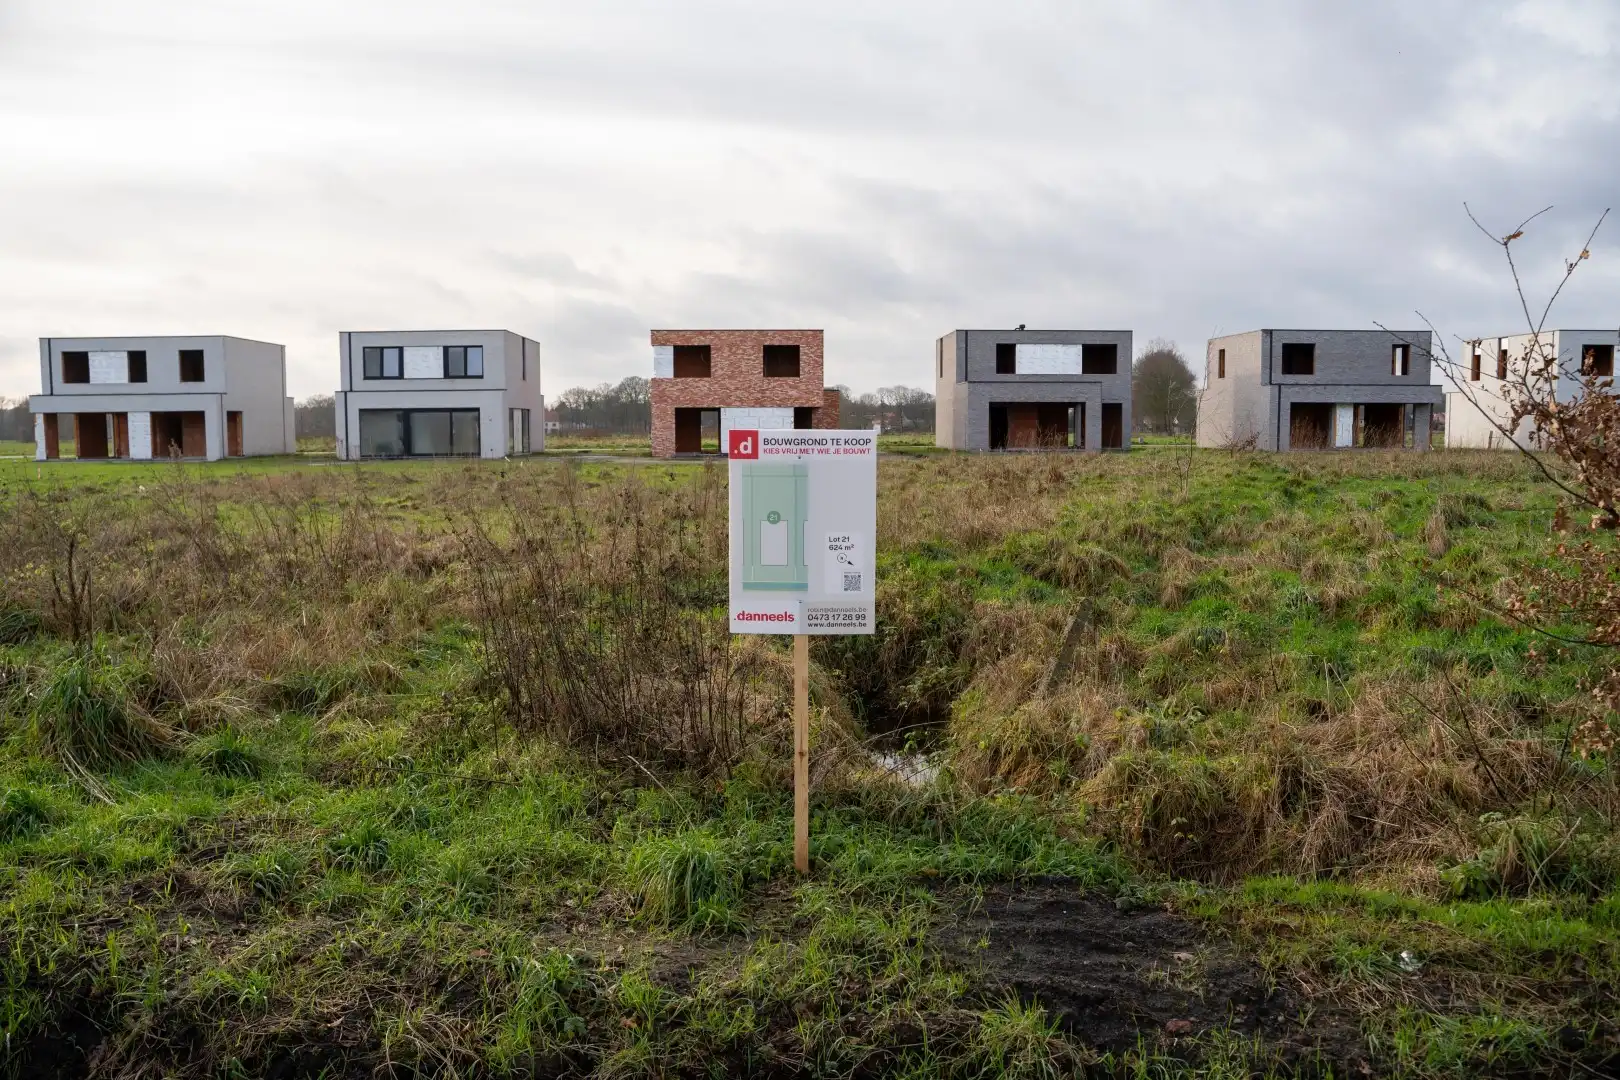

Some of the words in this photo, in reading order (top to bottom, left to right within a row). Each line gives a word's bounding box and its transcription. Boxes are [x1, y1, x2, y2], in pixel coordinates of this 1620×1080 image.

[763, 438, 828, 446] BOUWGROND
[830, 438, 842, 446] TE
[844, 438, 872, 446] KOOP
